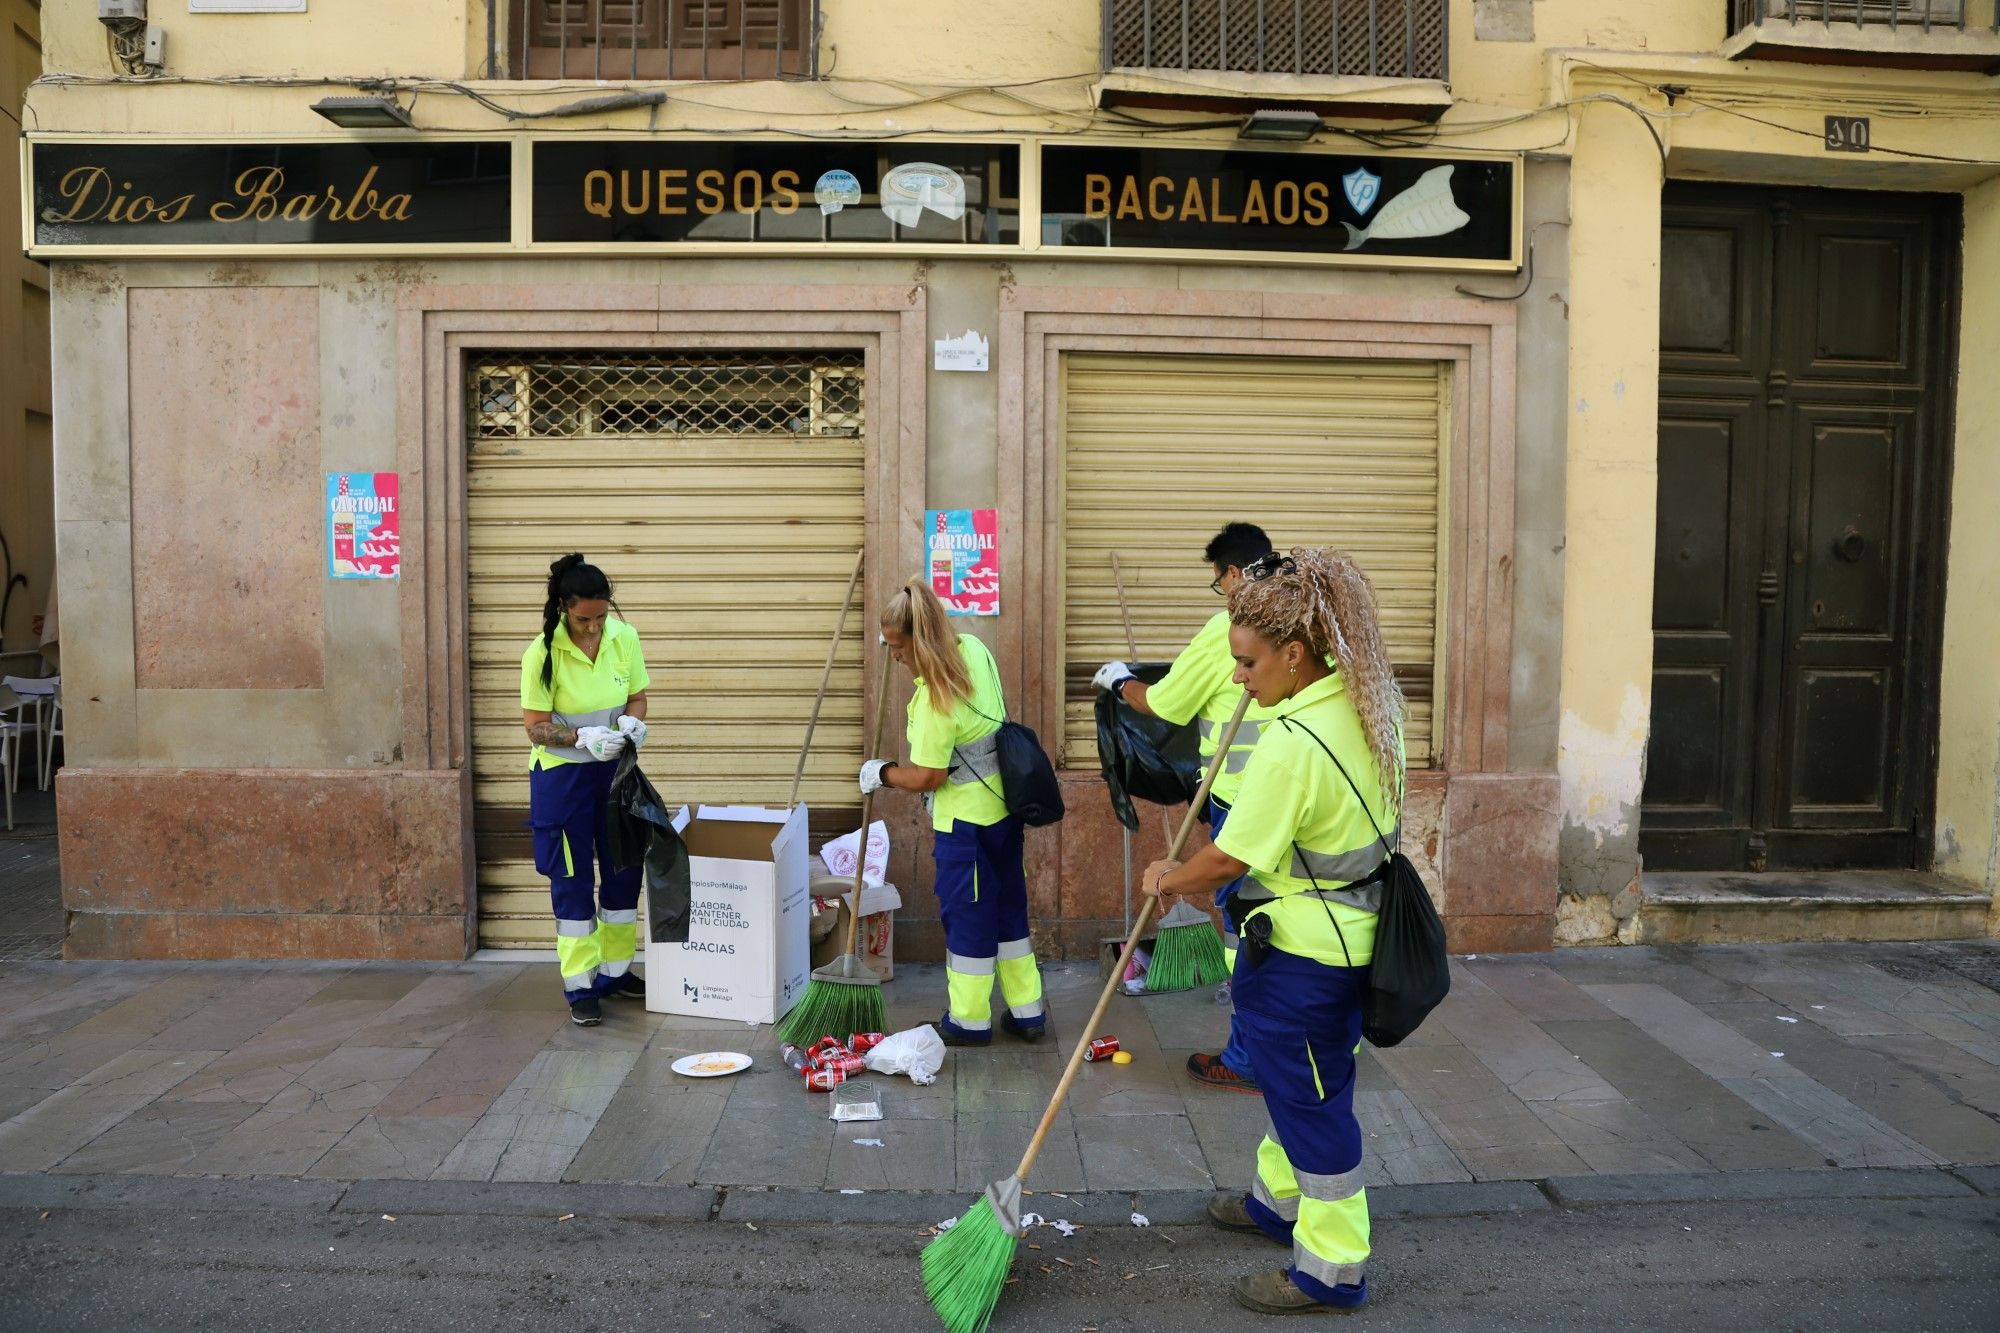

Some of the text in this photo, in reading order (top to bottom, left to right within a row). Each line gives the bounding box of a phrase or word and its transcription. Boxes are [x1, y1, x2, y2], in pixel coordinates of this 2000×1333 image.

[41, 165, 414, 224] Dios Barba
[583, 169, 802, 218] QUESOS
[1084, 173, 1329, 226] BACALAOS
[331, 496, 395, 515] CARTOJAL
[929, 533, 995, 551] CARTOJAL
[689, 901, 733, 911] OLABORA
[699, 918, 711, 926] TU
[713, 918, 750, 929] CIUDAD
[681, 942, 735, 954] GRACIAS
